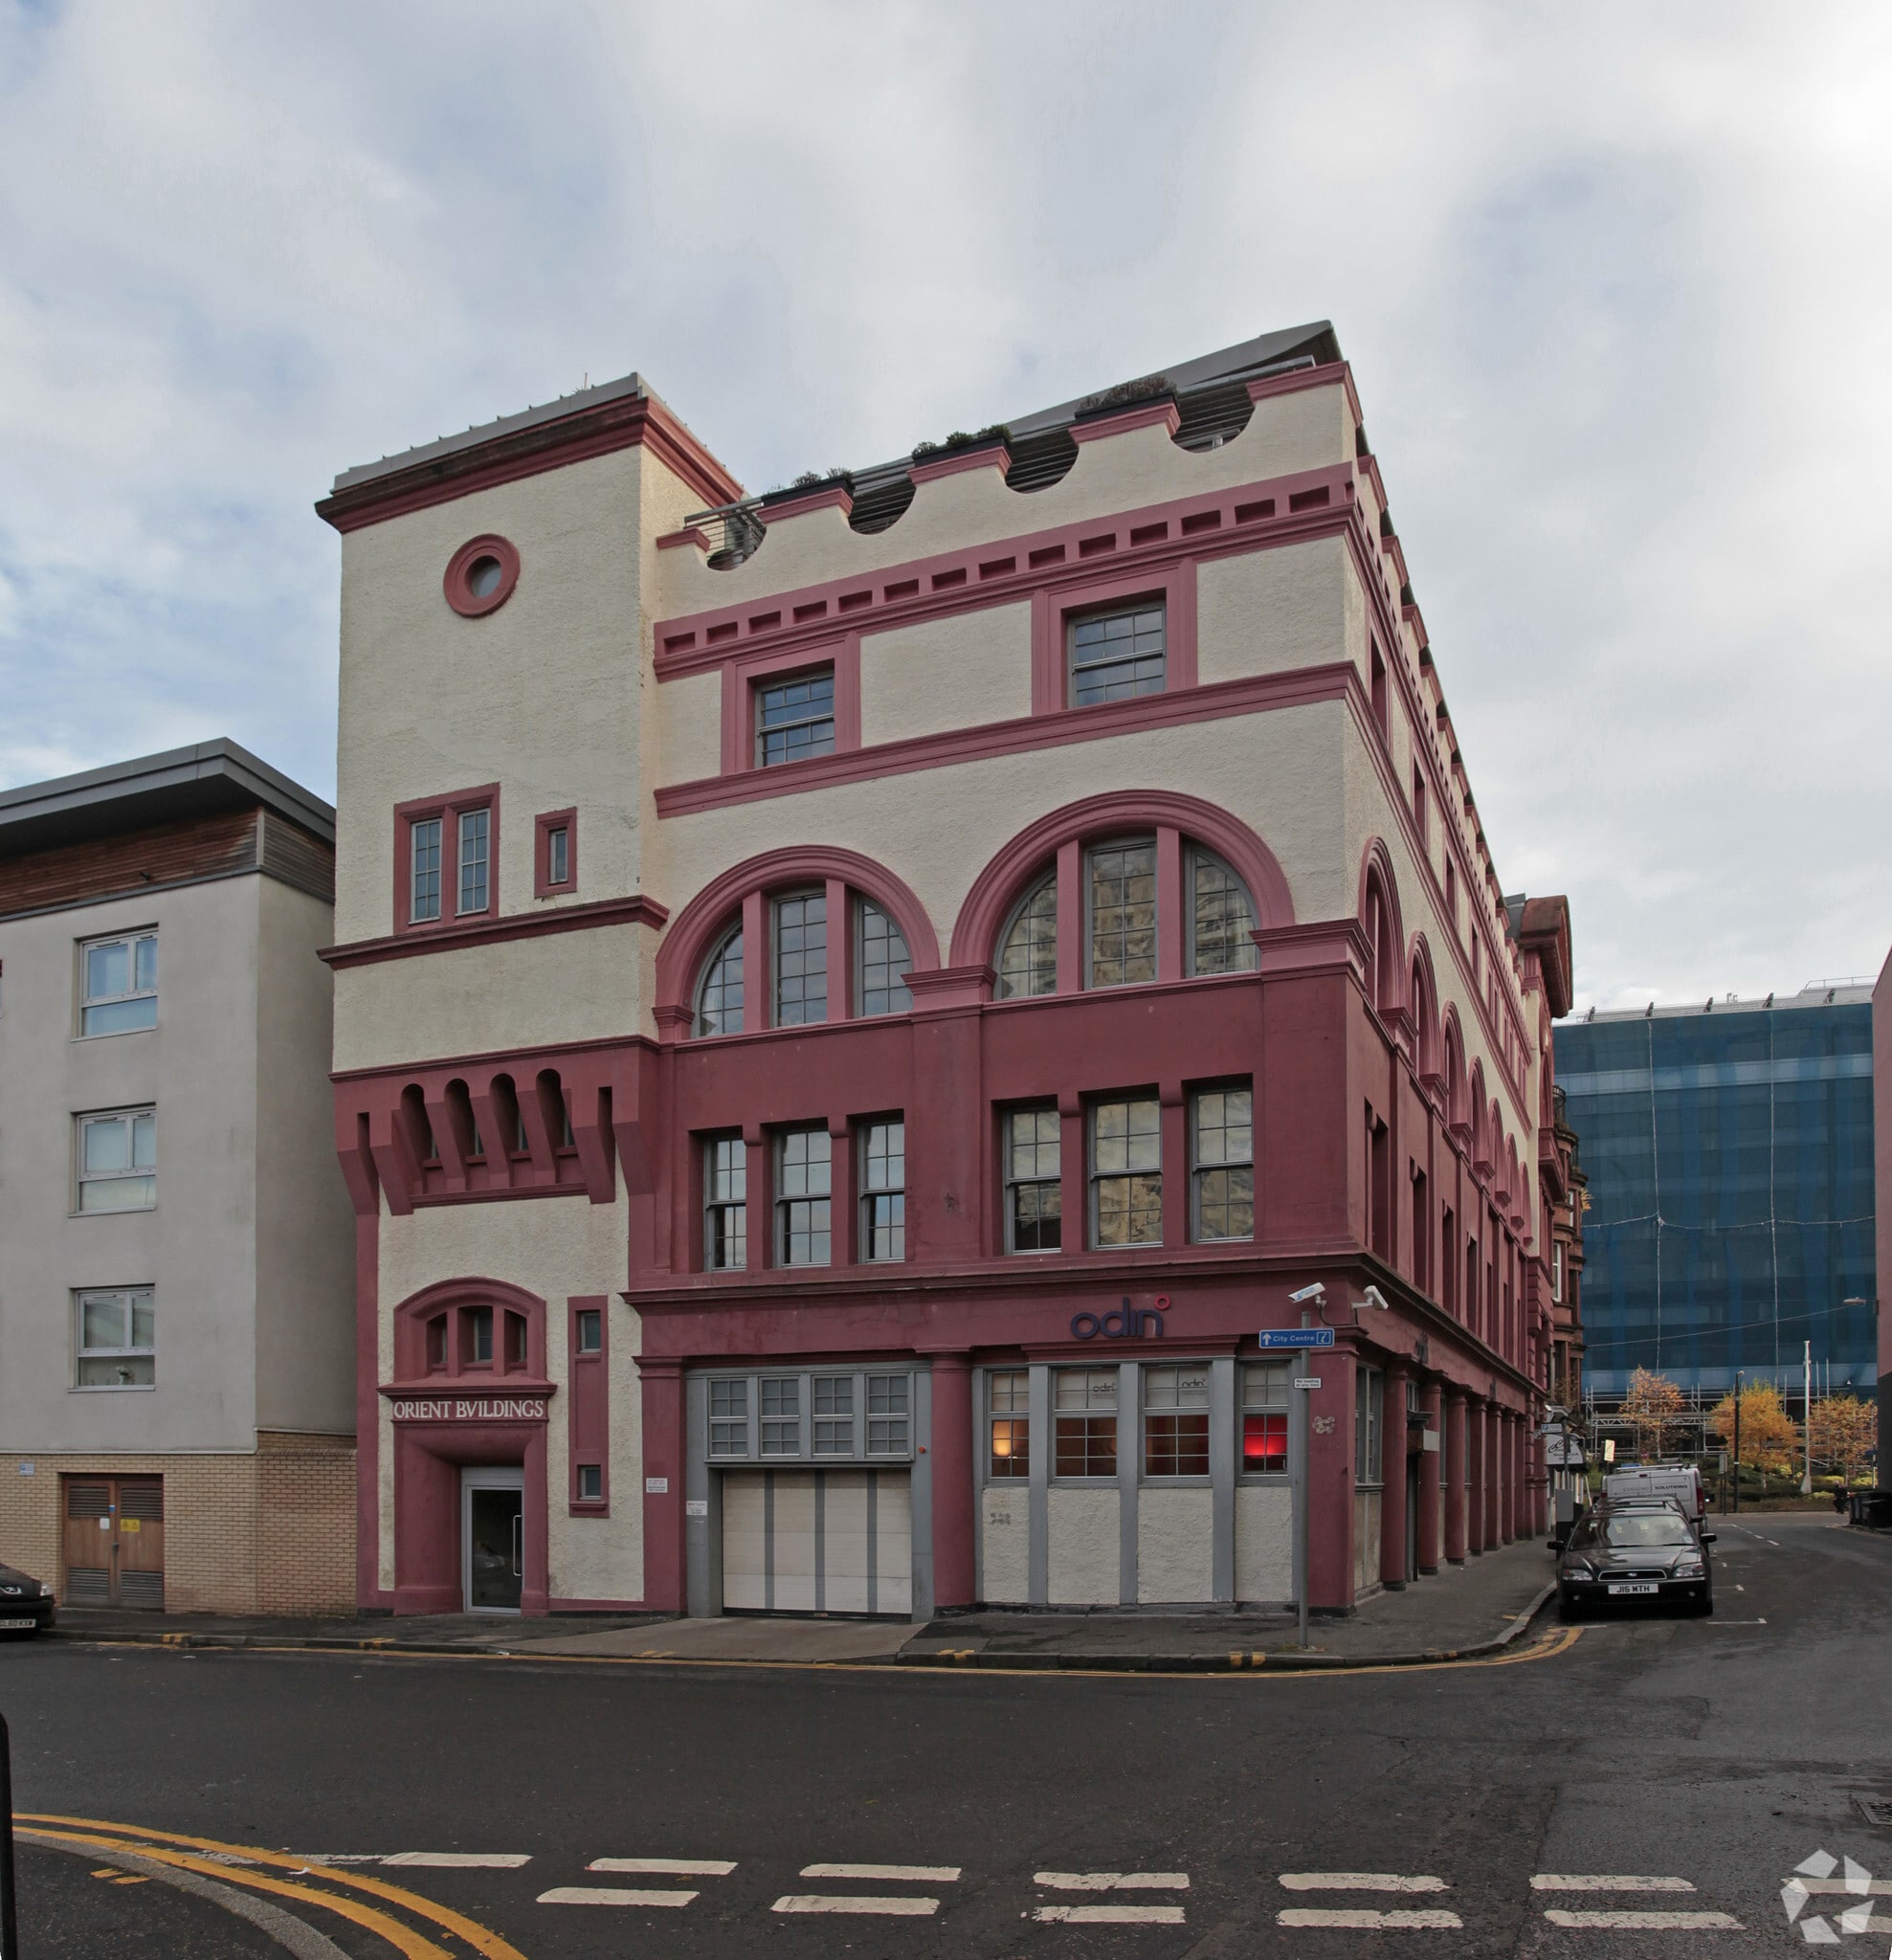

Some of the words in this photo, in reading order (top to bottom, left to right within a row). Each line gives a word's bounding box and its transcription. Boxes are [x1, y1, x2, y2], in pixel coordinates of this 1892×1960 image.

[1070, 1297, 1164, 1339] odin
[393, 1401, 453, 1418] ORIENT
[456, 1400, 544, 1417] BVILDINGS
